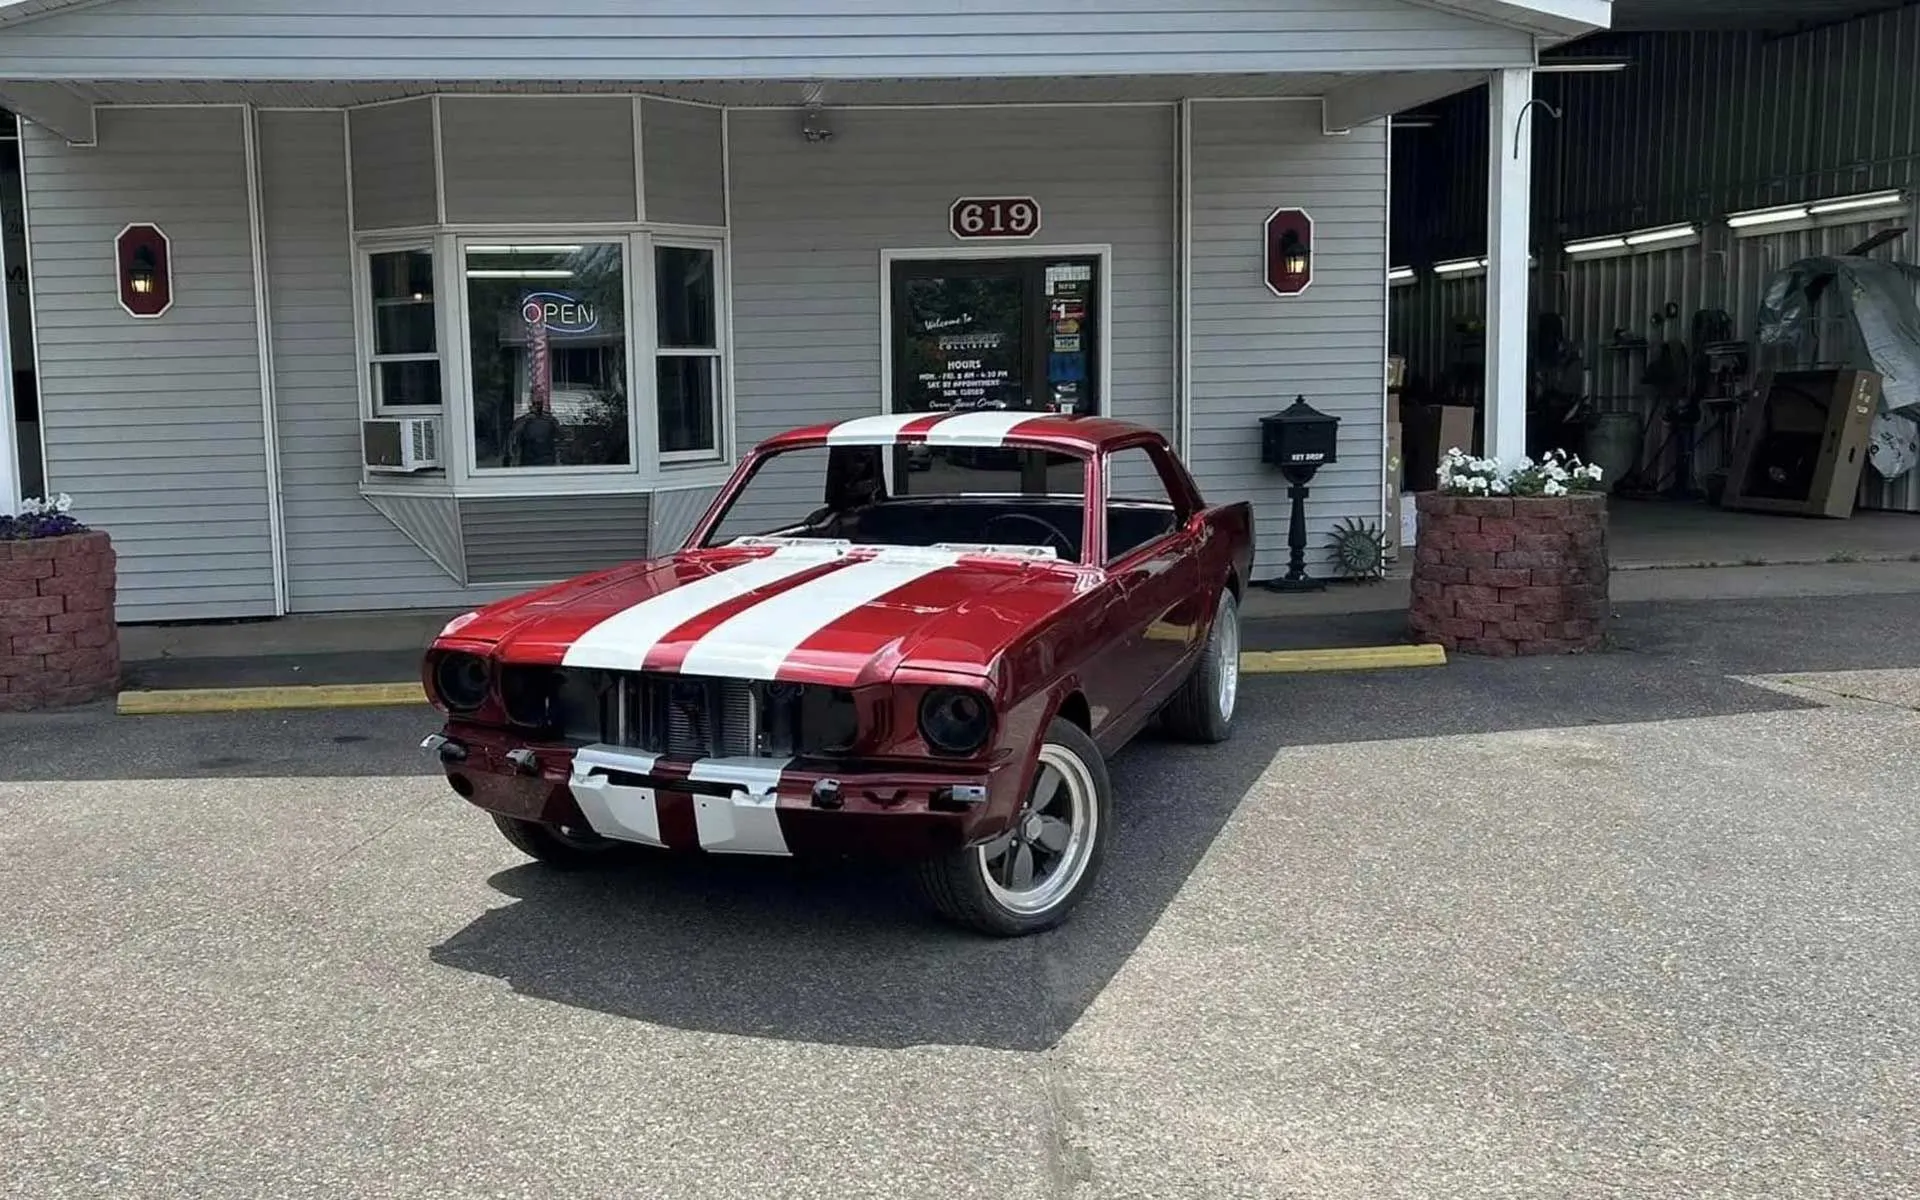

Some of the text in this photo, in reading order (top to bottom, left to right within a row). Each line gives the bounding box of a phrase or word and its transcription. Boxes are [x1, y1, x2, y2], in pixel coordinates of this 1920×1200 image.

[960, 203, 1032, 232] 619
[522, 303, 594, 324] OPEN
[925, 317, 960, 330] Welcome
[947, 360, 981, 370] HOURS
[997, 370, 1008, 378] PM
[952, 379, 1000, 388] APPOINTMENT
[960, 388, 985, 396] CLOSED
